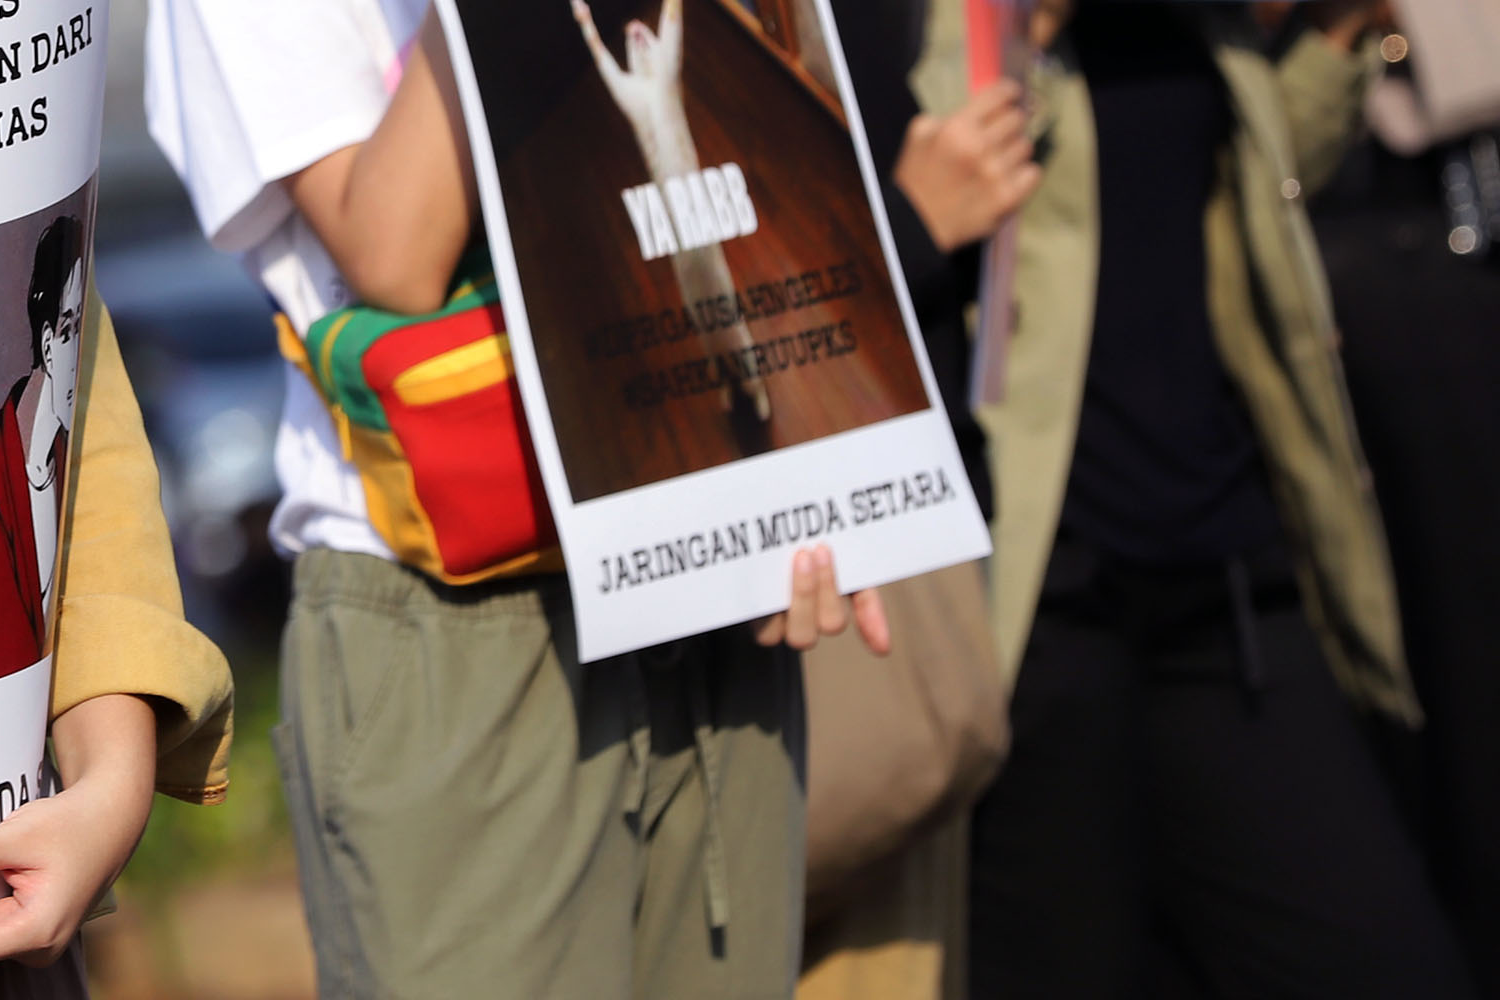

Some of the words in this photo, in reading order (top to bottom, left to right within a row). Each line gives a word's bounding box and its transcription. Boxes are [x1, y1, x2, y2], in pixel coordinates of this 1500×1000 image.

[31, 6, 93, 73] DARI
[598, 520, 750, 594] JARINGAN
[756, 498, 844, 551] MUDA
[849, 466, 957, 527] SETARA
